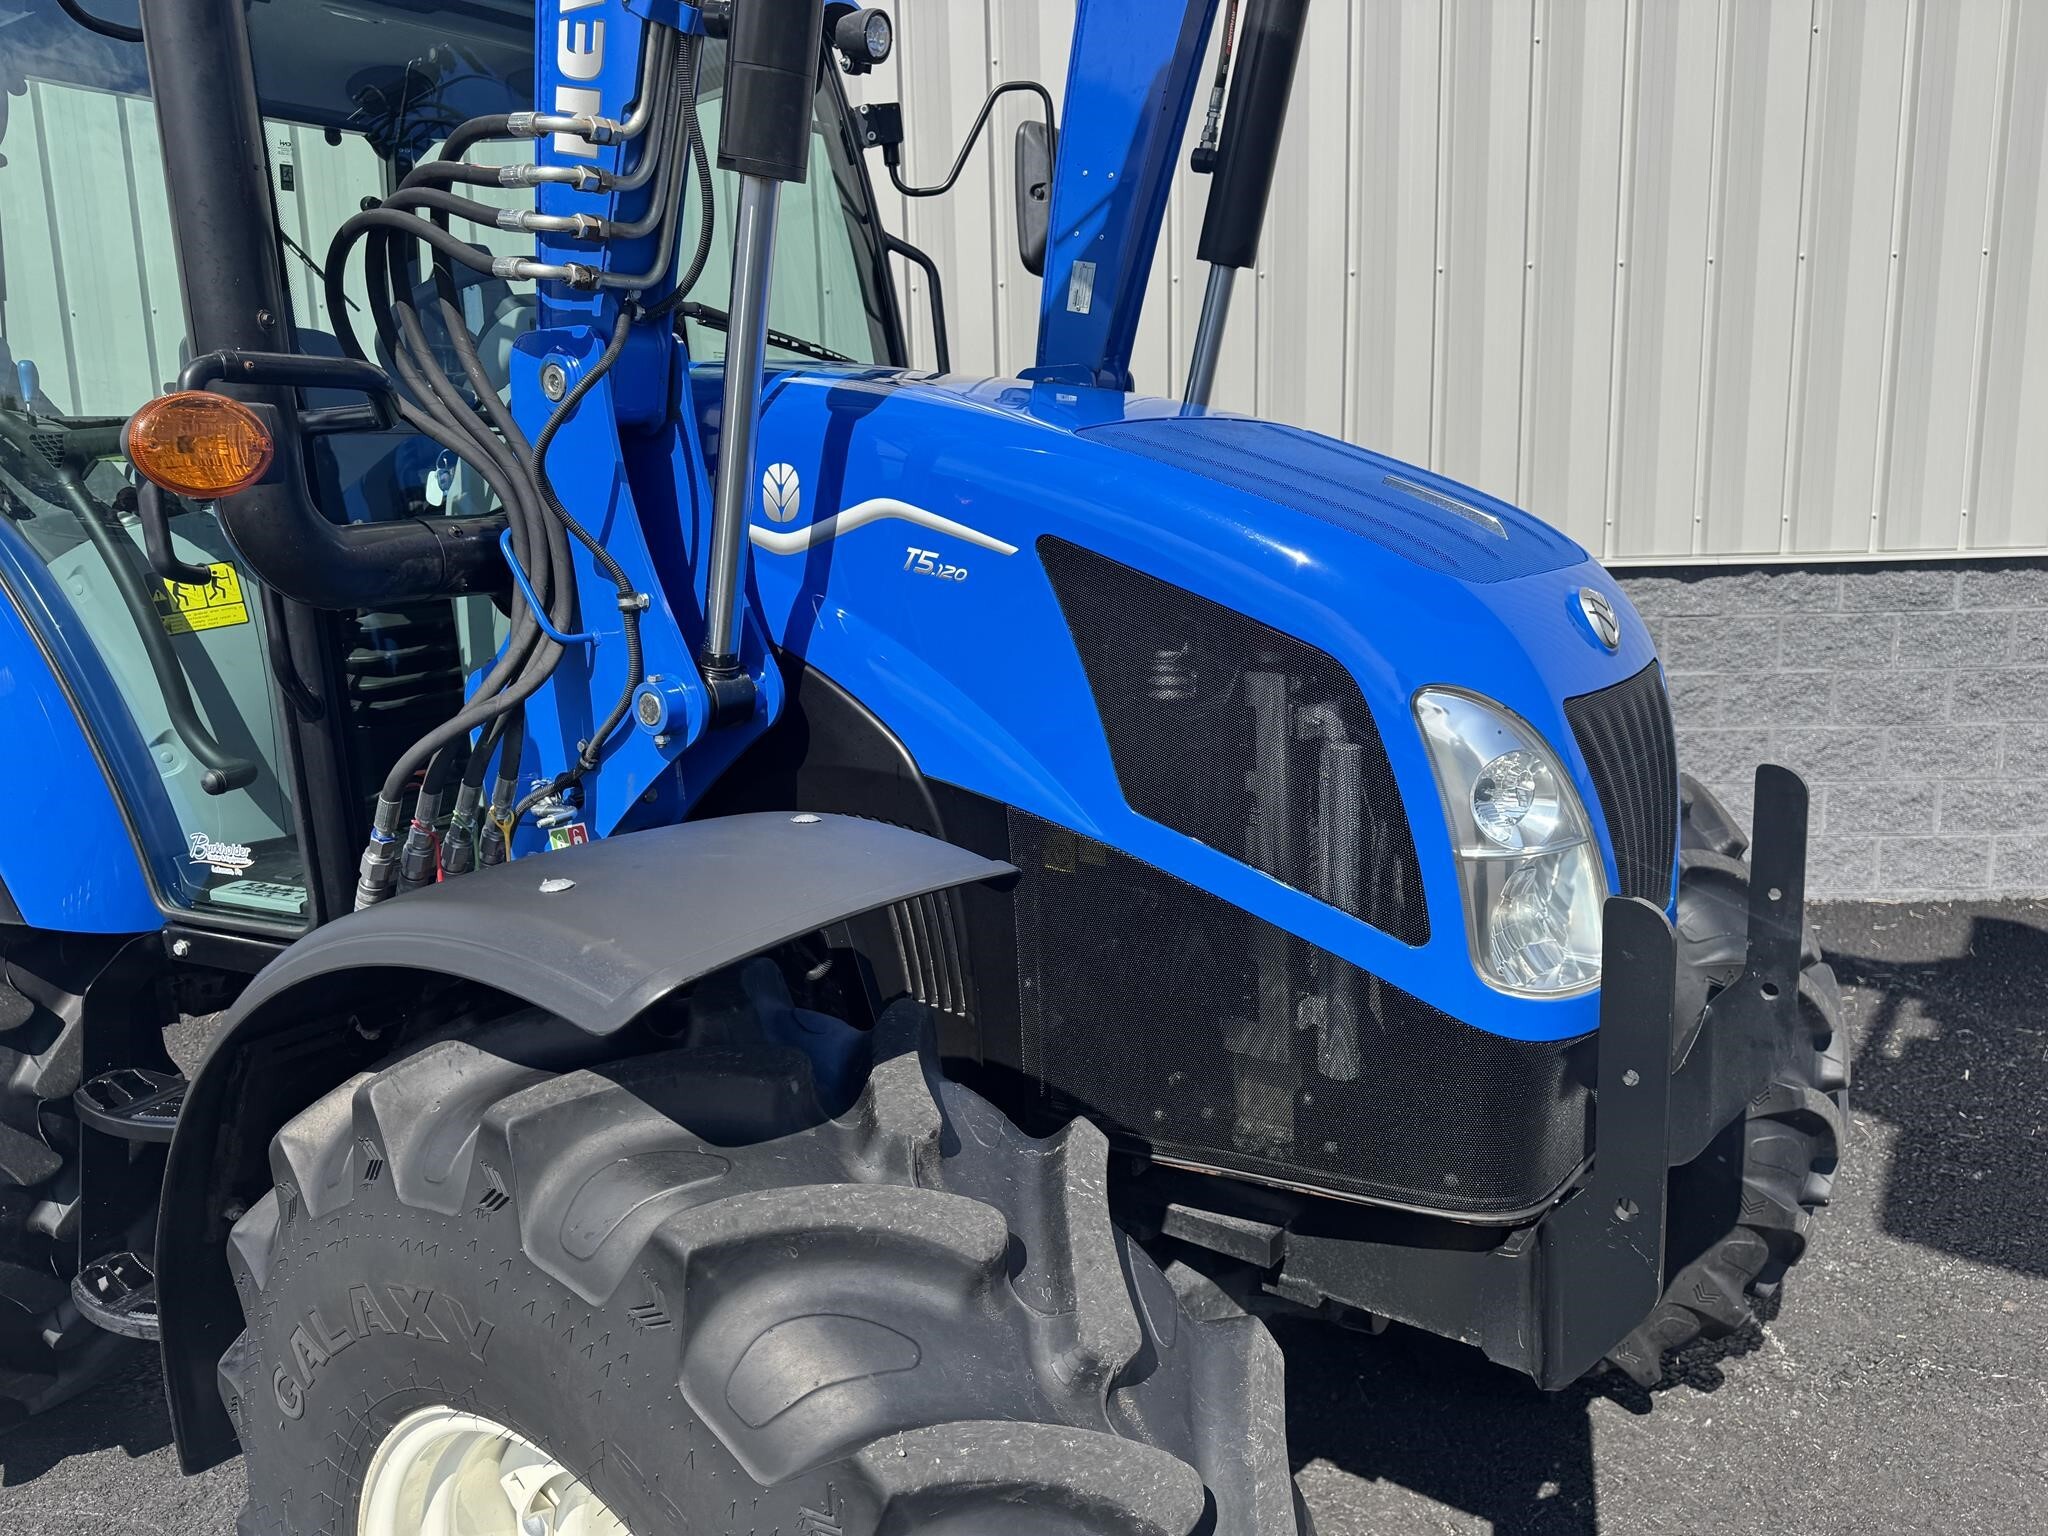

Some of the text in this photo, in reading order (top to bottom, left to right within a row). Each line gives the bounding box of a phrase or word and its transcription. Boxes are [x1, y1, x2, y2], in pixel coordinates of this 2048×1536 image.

[554, 0, 604, 158] NE
[904, 547, 968, 581] T5.120
[189, 832, 251, 860] Burkholder
[272, 1283, 496, 1421] GALAXY
